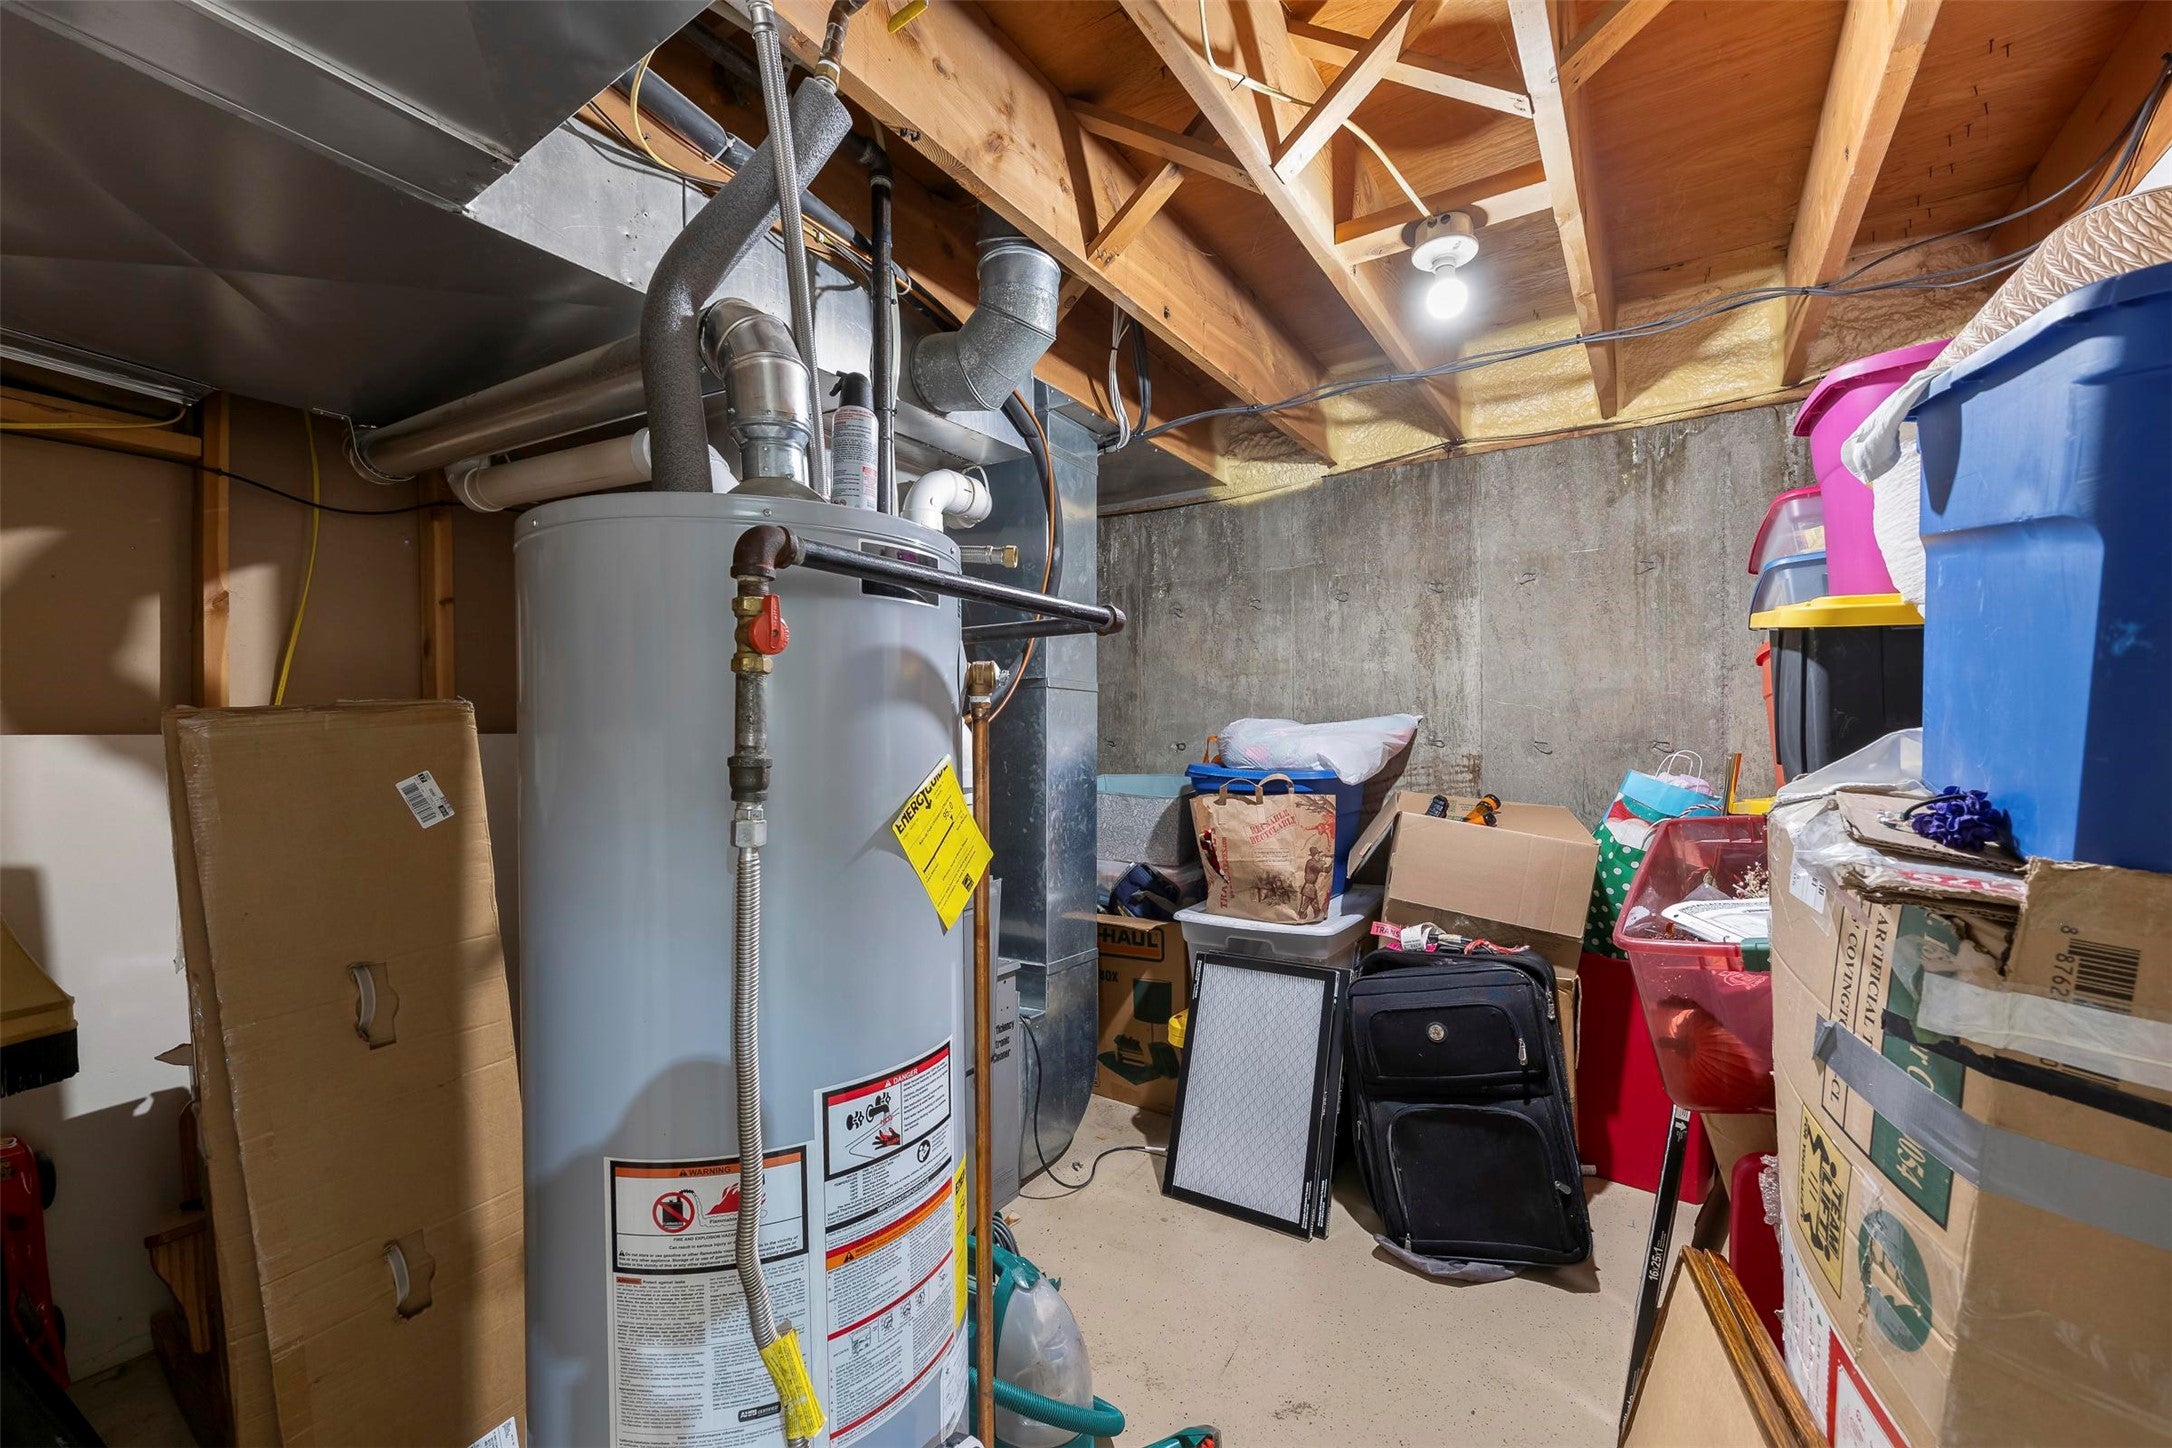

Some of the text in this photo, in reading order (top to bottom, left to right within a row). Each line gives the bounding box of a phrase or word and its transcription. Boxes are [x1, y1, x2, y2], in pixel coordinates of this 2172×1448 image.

[895, 765, 948, 835] ENERGYGUI
[1250, 809, 1289, 834] REUSABLE
[1250, 815, 1296, 844] RECYCLABLE
[1838, 932, 1858, 1029] COVINGTO
[1863, 912, 1888, 1029] ARTIFICIAL
[2050, 952, 2075, 1003] 8762
[893, 1069, 918, 1084] DANGER
[689, 1166, 731, 1177] WARNING
[1819, 1166, 1833, 1239] LIFT
[1828, 1191, 1844, 1258] TEAM
[1648, 1246, 1663, 1281] 16x25x1
